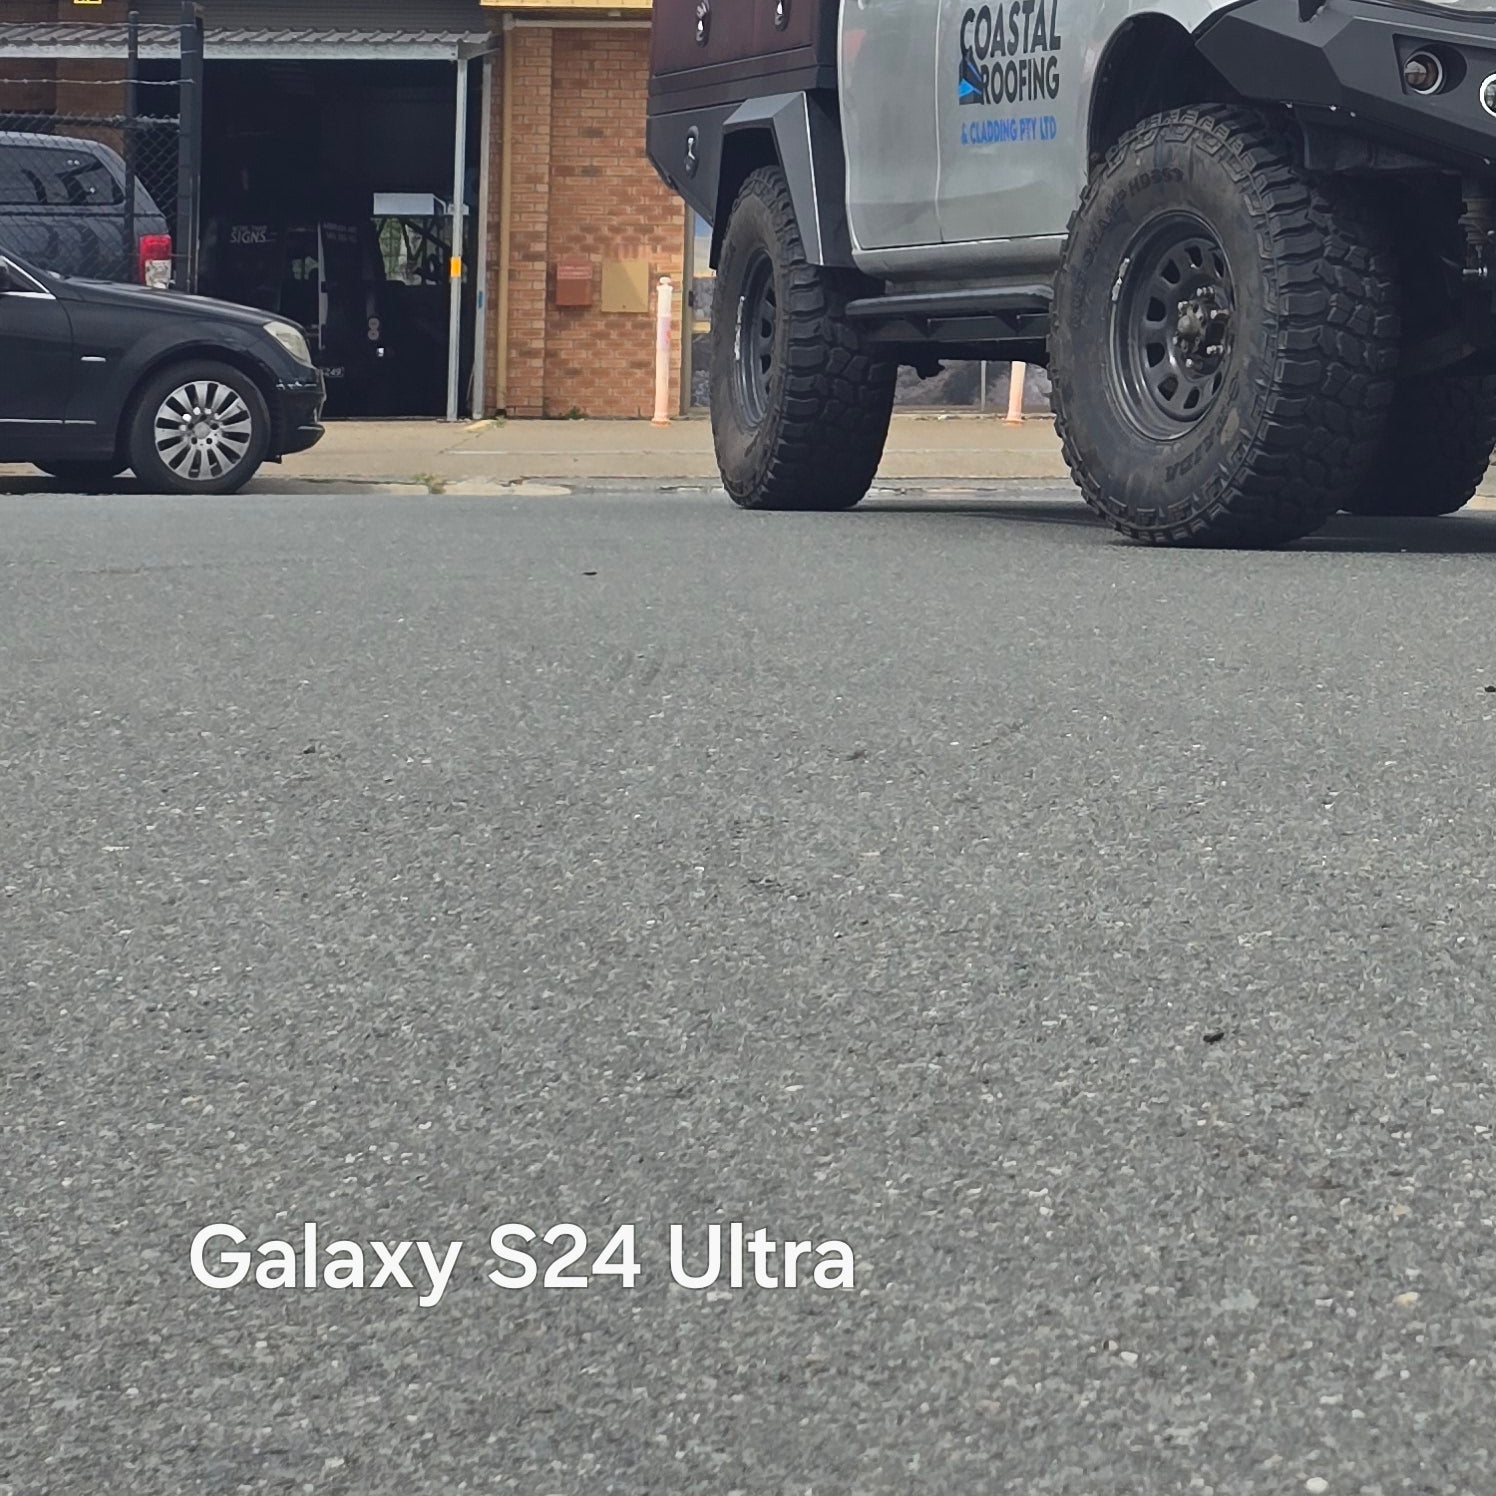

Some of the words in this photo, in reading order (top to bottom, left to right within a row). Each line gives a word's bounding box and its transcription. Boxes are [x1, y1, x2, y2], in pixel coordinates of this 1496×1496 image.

[981, 55, 1060, 105] ROOFING
[969, 119, 1018, 144] CLADDING
[1019, 117, 1037, 141] PTY
[1040, 115, 1057, 140] LTD
